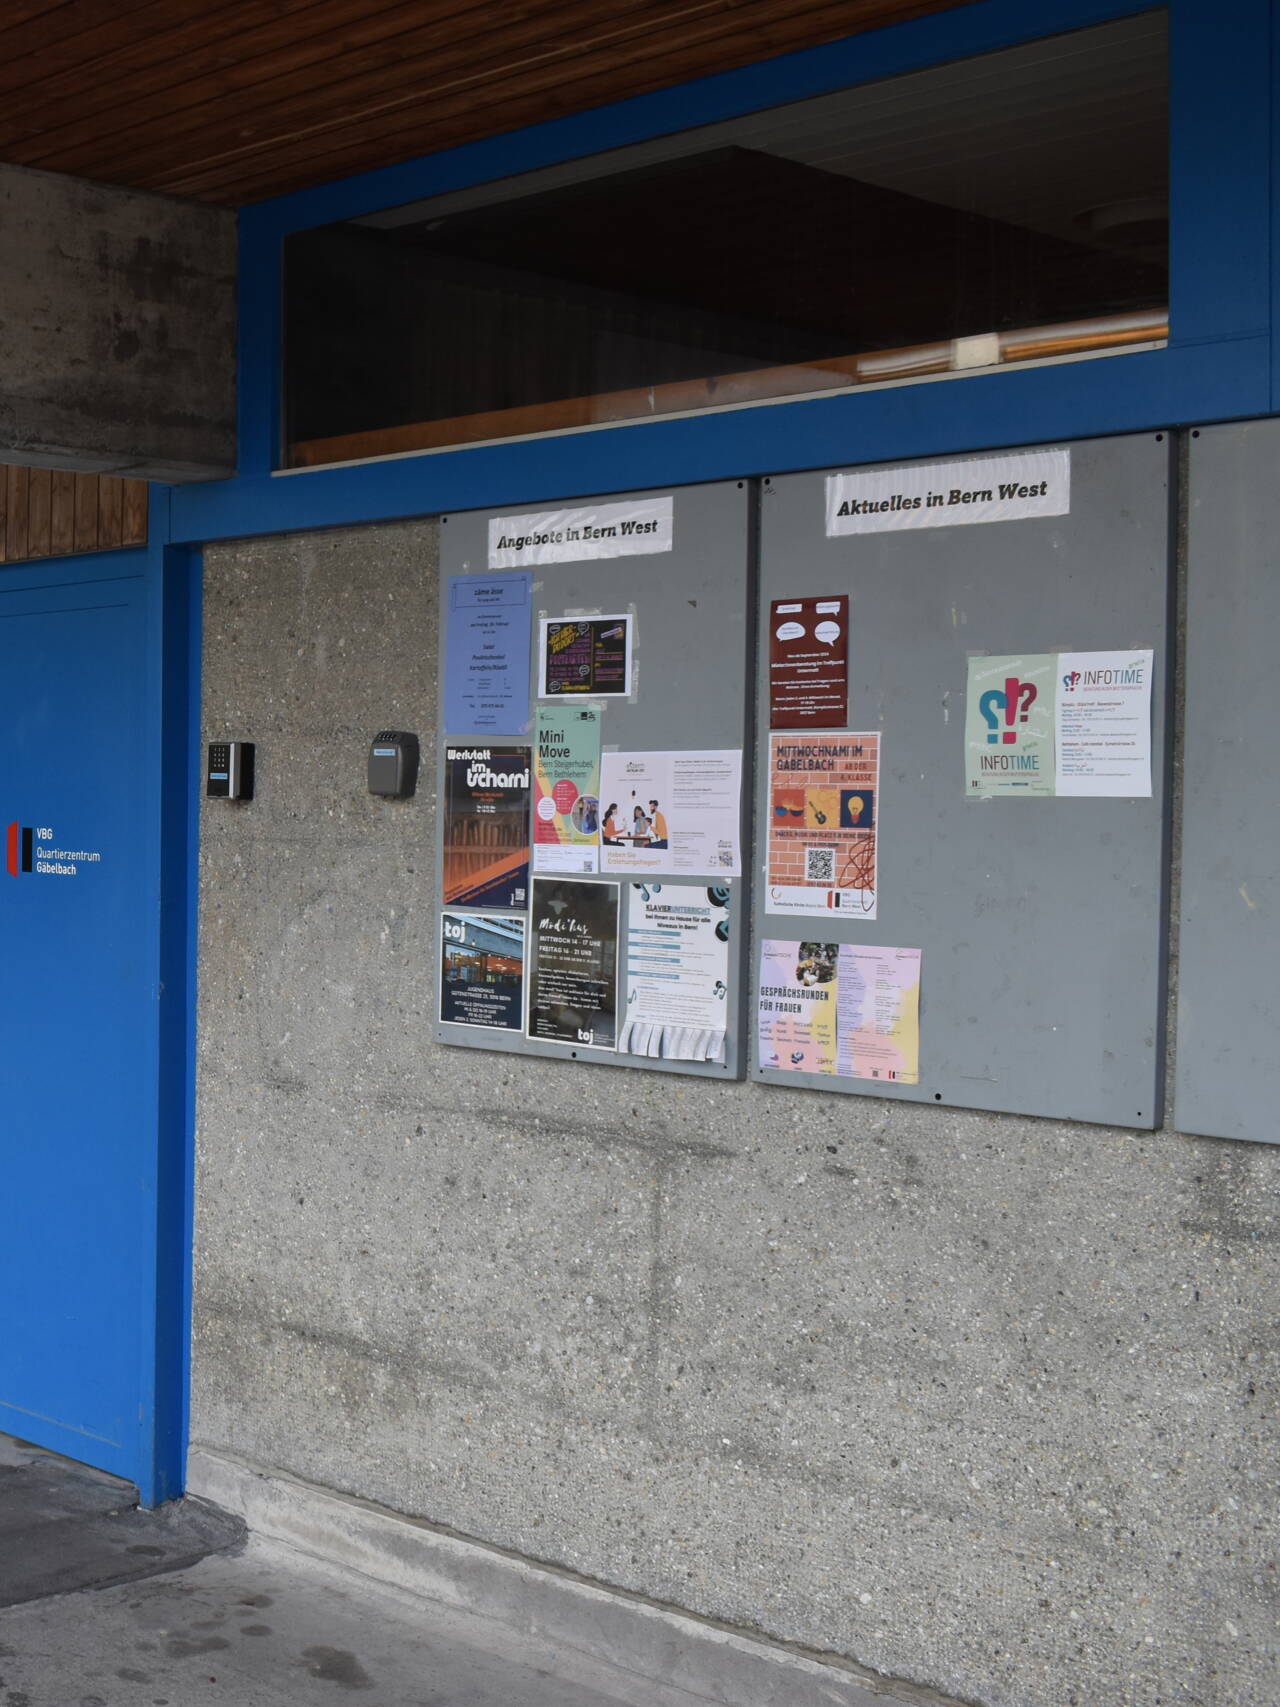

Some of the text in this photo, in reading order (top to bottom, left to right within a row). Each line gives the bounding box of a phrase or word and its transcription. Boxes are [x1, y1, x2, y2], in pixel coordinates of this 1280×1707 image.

[837, 481, 1048, 516] Aktuelles in Bern West
[497, 520, 658, 550] Angebote in Bern West
[1083, 669, 1144, 685] INFOTIME
[539, 729, 564, 743] Mini
[447, 749, 491, 760] Werkstatt
[539, 745, 570, 758] Move
[852, 745, 863, 757] IM
[471, 760, 486, 773] im
[980, 755, 1040, 770] INFOTIME
[467, 768, 530, 788] tscharni
[847, 773, 873, 781] KLASSE
[36, 828, 53, 840] VBG
[36, 846, 101, 862] Quartierzentrum
[36, 861, 77, 875] Gäbelbach
[444, 921, 466, 943] toj
[540, 935, 570, 944] MITTWOCH
[539, 945, 562, 953] FREITAG
[760, 985, 829, 1001] GESPRÄCHSRUNDEN
[760, 999, 802, 1014] FÜR FRAUEN
[578, 1028, 594, 1044] toj
